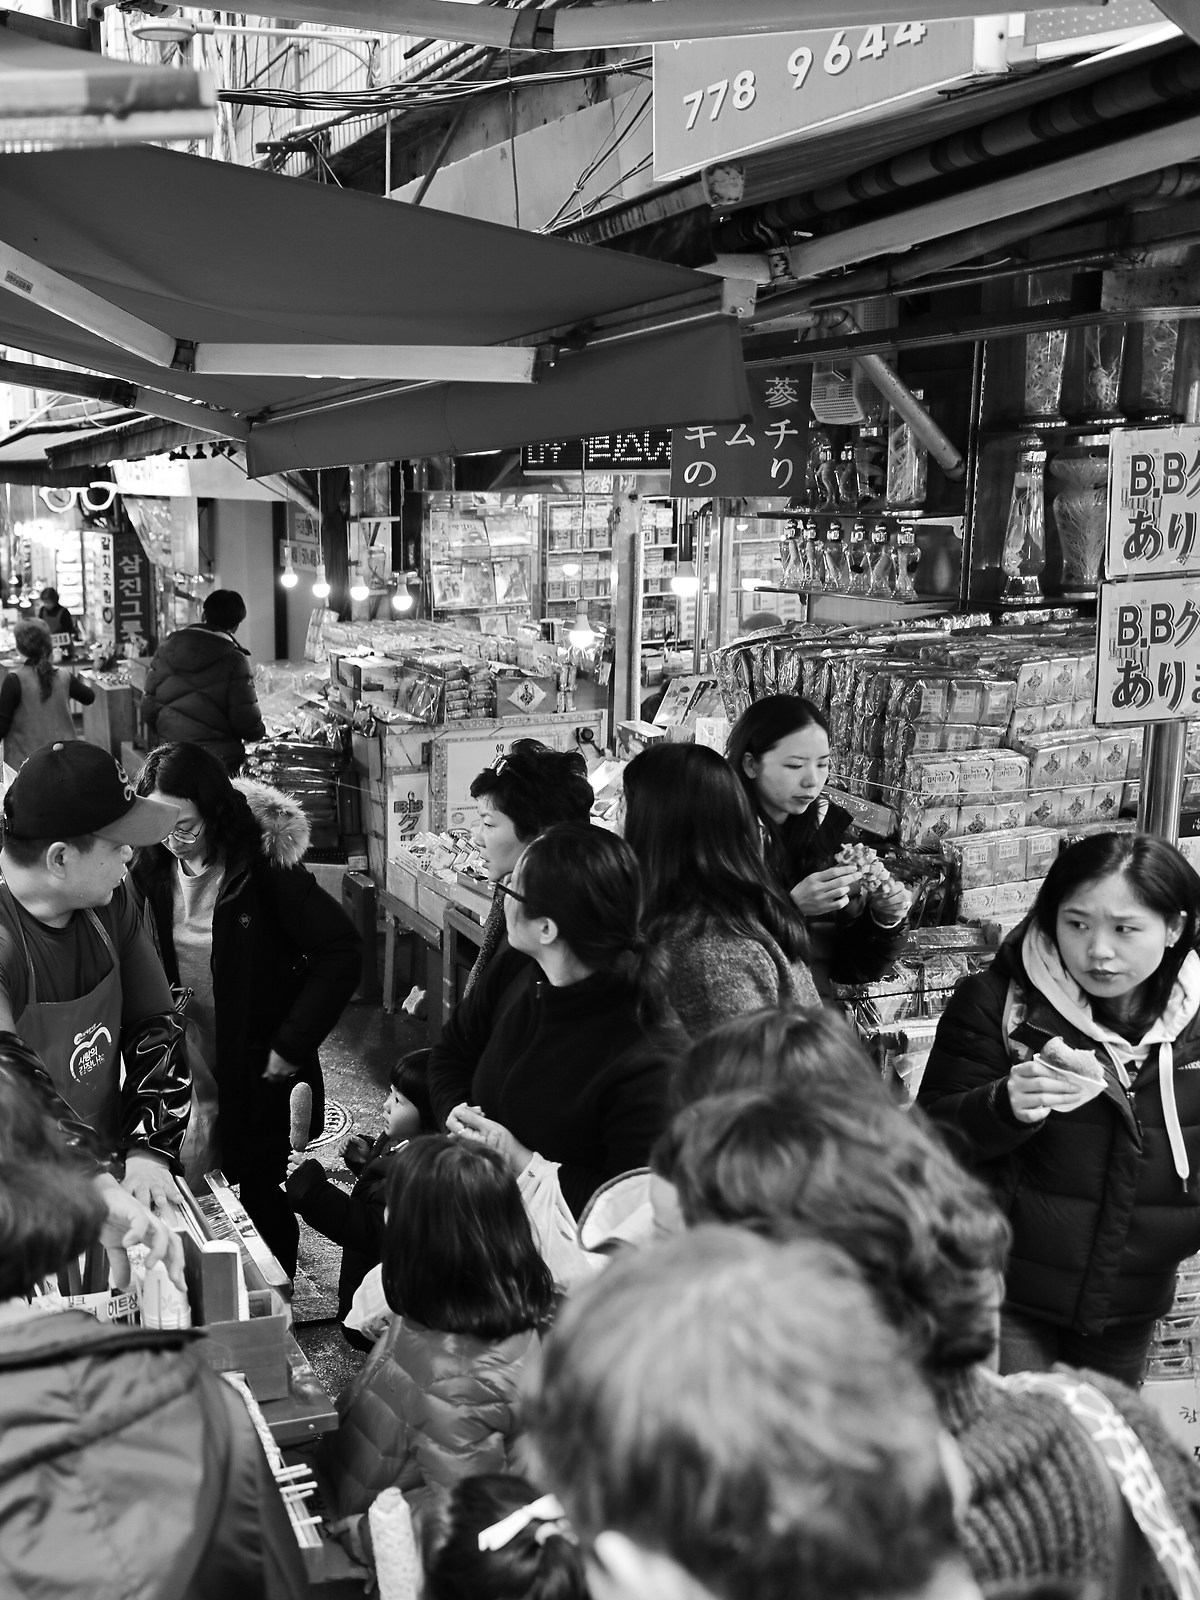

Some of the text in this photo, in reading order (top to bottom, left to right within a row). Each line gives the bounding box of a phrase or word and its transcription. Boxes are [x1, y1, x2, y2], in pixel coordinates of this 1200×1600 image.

[682, 21, 928, 130] 778 9644
[101, 536, 112, 604] 갈치조림
[78, 1046, 98, 1066] 사랑의
